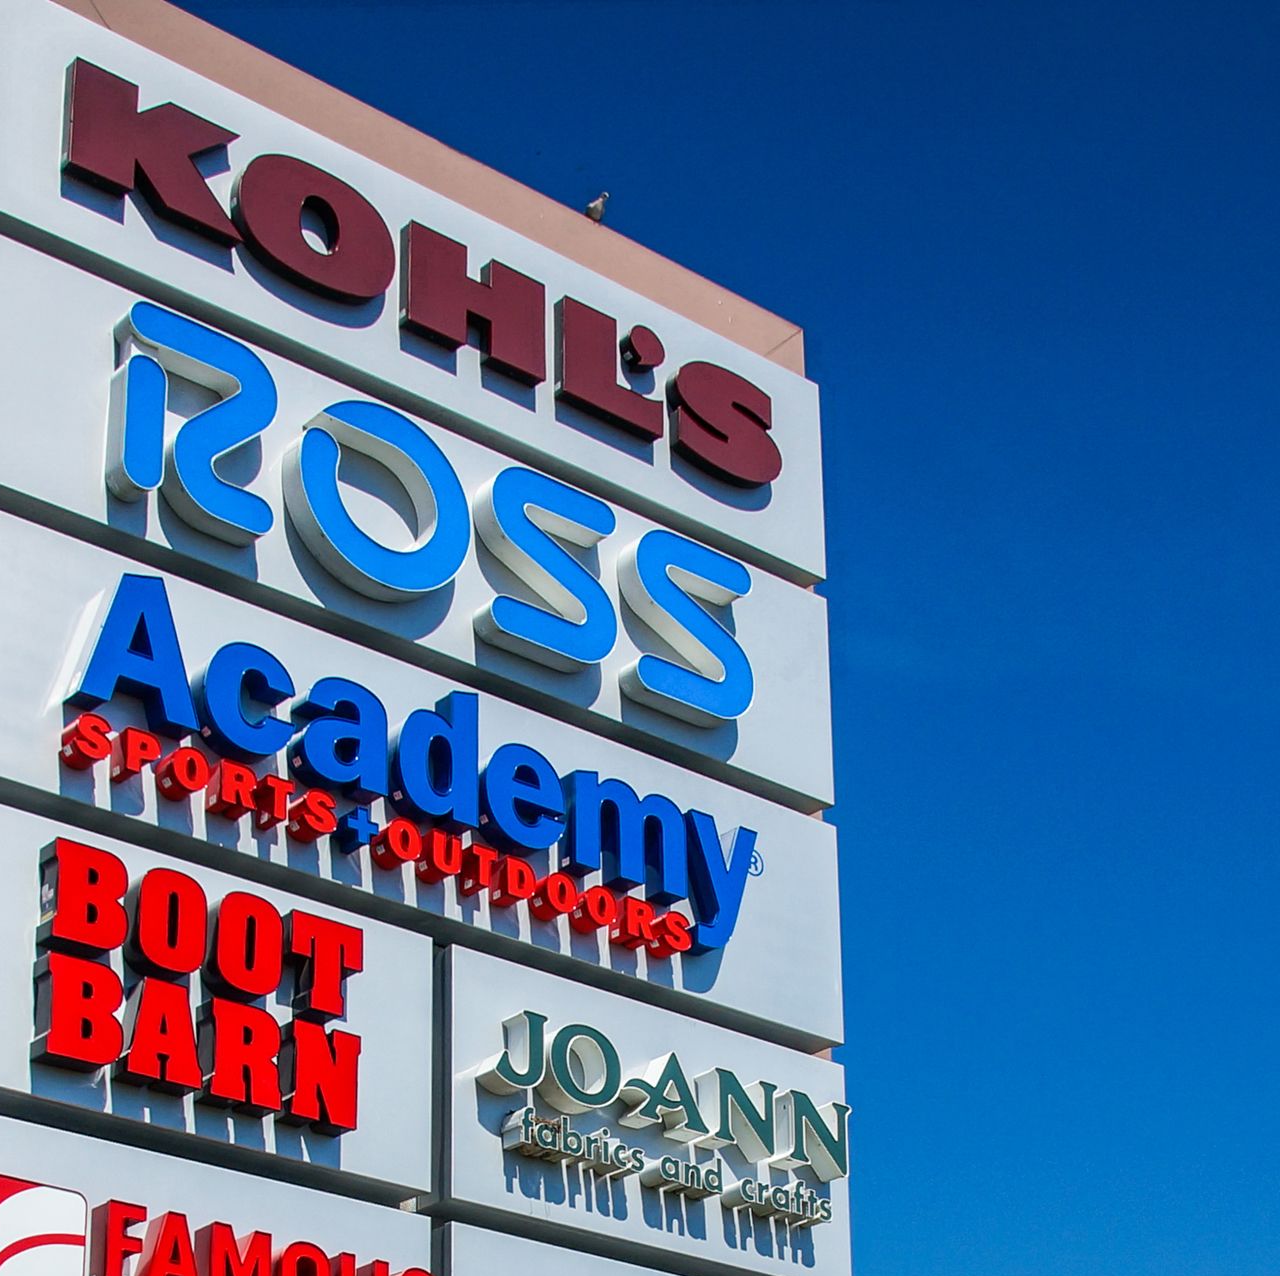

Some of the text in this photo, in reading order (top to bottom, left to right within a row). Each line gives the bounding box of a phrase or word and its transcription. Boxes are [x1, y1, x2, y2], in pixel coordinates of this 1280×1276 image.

[63, 57, 783, 489] KOHL'S
[108, 301, 753, 728] ROSS
[42, 837, 363, 1020] BOOT
[34, 953, 362, 1136] BARN
[510, 1106, 834, 1223] fabrics and crafts
